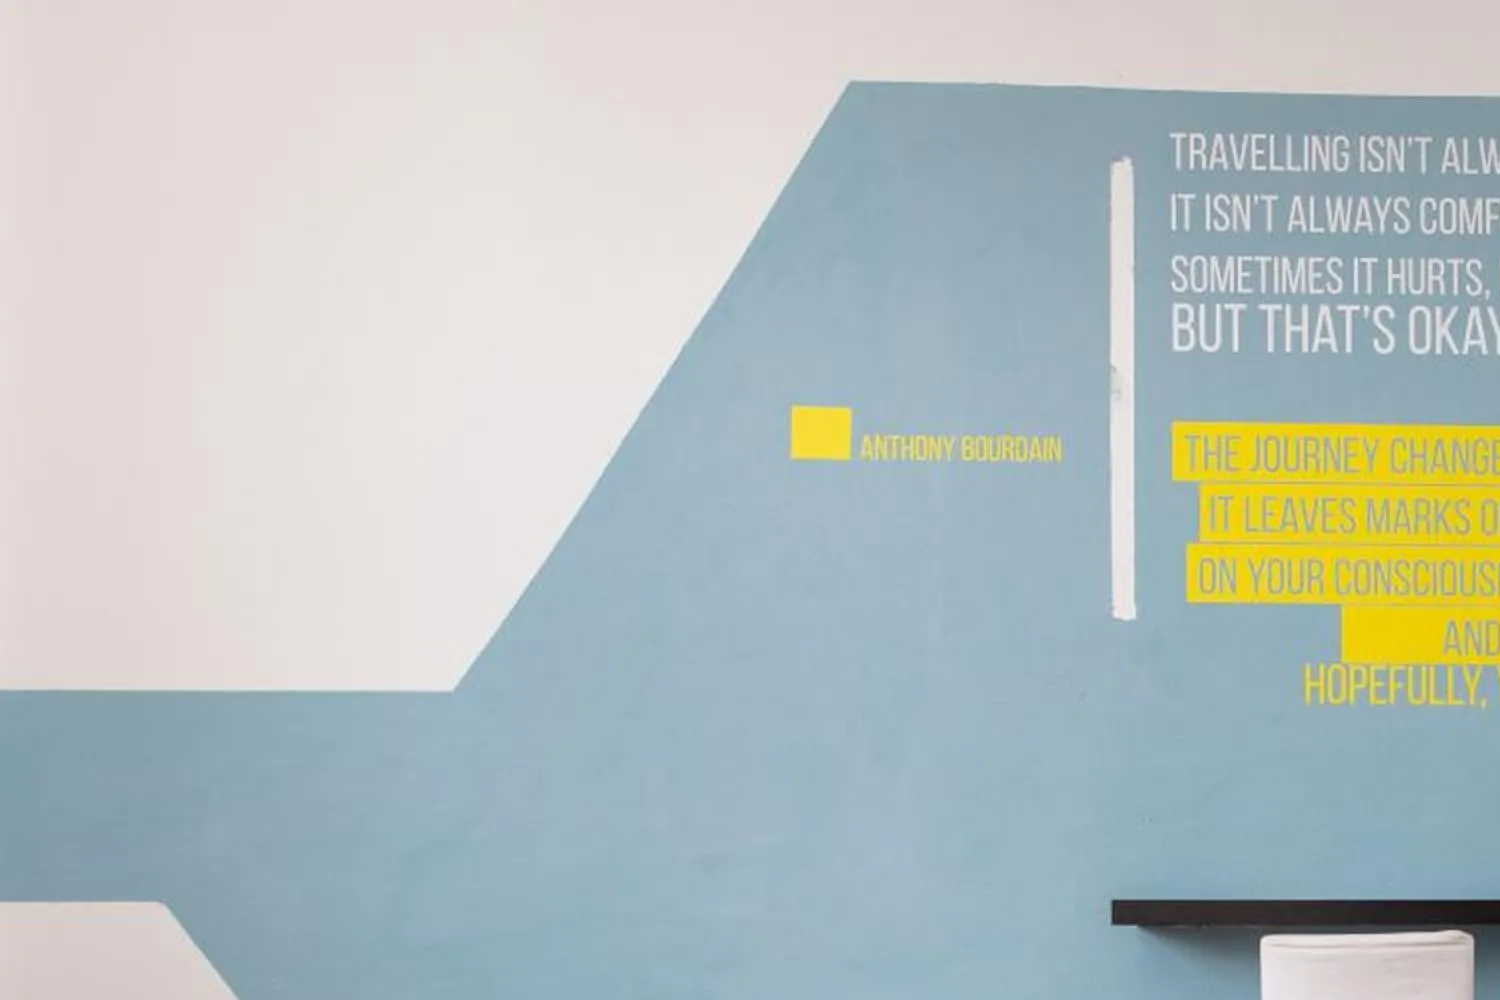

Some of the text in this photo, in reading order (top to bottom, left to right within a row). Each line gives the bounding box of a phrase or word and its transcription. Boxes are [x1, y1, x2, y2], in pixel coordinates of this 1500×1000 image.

[1170, 132, 1350, 173] TRAVELLING
[1359, 135, 1433, 175] ISN'T
[1170, 194, 1196, 232] IT
[1205, 195, 1279, 233] ISN'T
[1286, 196, 1411, 235] ALWAYS
[1170, 255, 1344, 294] SOMETIMES
[1352, 257, 1379, 295] IT
[1386, 258, 1491, 301] HURTS,
[1171, 303, 1247, 354] BUT
[1258, 304, 1397, 355] THAT'S
[860, 433, 1062, 463] ANTHONY BOURDAIN
[1184, 434, 1241, 473] THE
[1249, 435, 1381, 475] JOURNEY
[1209, 496, 1234, 532] IT
[1244, 496, 1357, 535] LEAVES
[1366, 498, 1472, 537] MARKS
[1199, 557, 1238, 595] ON
[1246, 558, 1325, 596] YOUR
[1304, 662, 1488, 709] HOPEFULLY,
